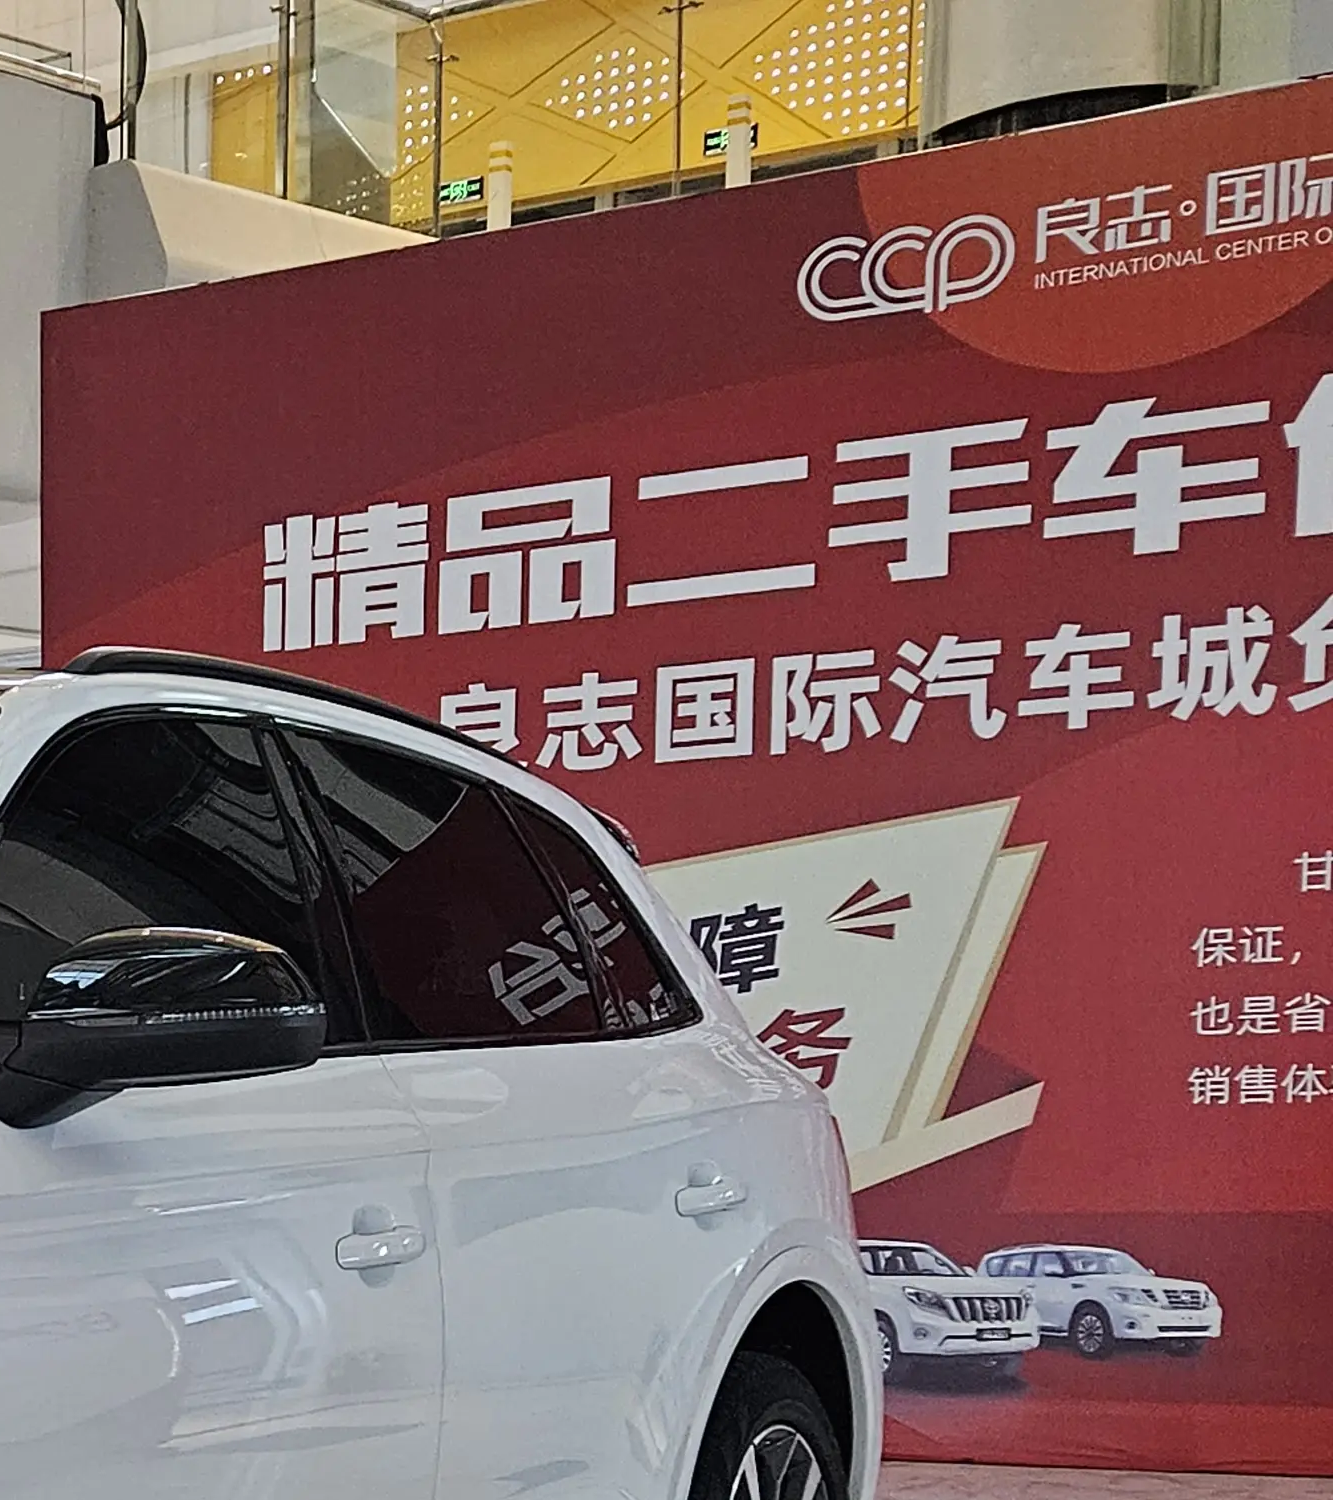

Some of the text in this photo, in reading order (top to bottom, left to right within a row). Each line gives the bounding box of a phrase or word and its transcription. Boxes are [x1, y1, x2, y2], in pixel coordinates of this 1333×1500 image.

[1034, 248, 1210, 289] INTERNATIONAL
[1214, 231, 1306, 262] CENTER
[261, 372, 1333, 652] 精品二手车
[690, 903, 785, 994] 障
[756, 1007, 854, 1090] 务
[1189, 992, 1332, 1036] 也是省
[1187, 1062, 1333, 1106] 销售体
